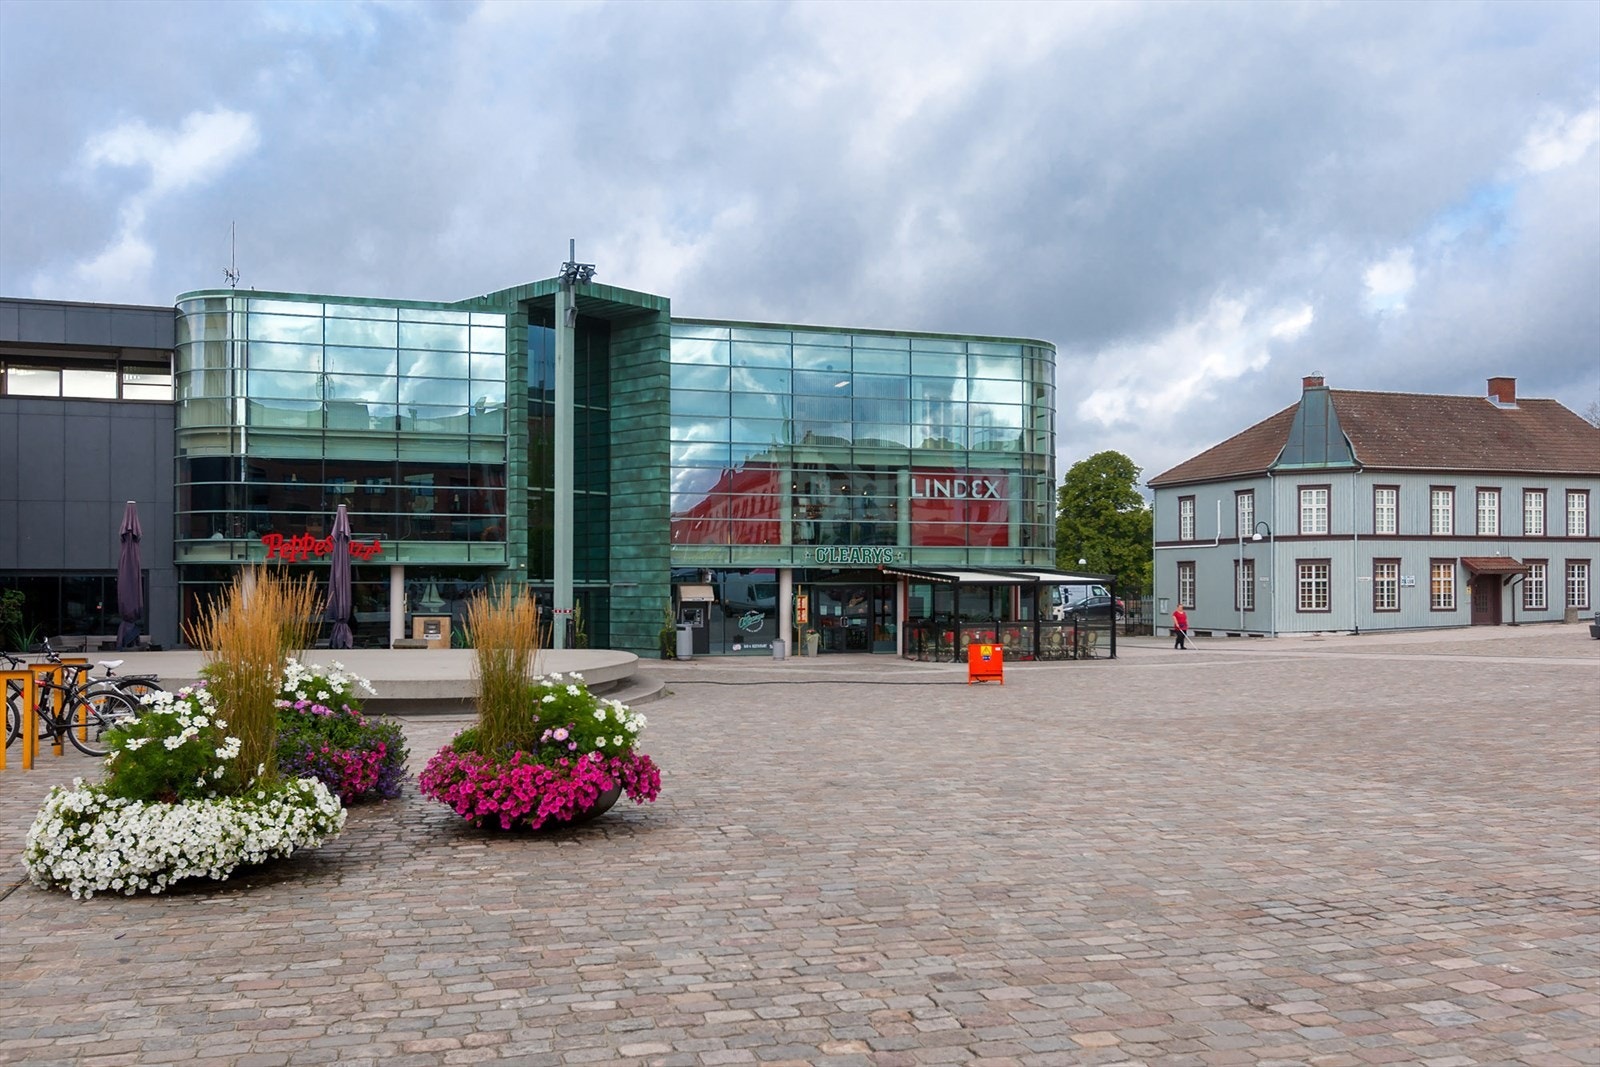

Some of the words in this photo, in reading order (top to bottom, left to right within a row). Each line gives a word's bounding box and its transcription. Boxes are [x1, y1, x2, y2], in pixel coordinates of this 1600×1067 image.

[911, 478, 1000, 498] LINDEX
[261, 532, 334, 562] Peppes
[816, 547, 893, 563] O'LEARYS
